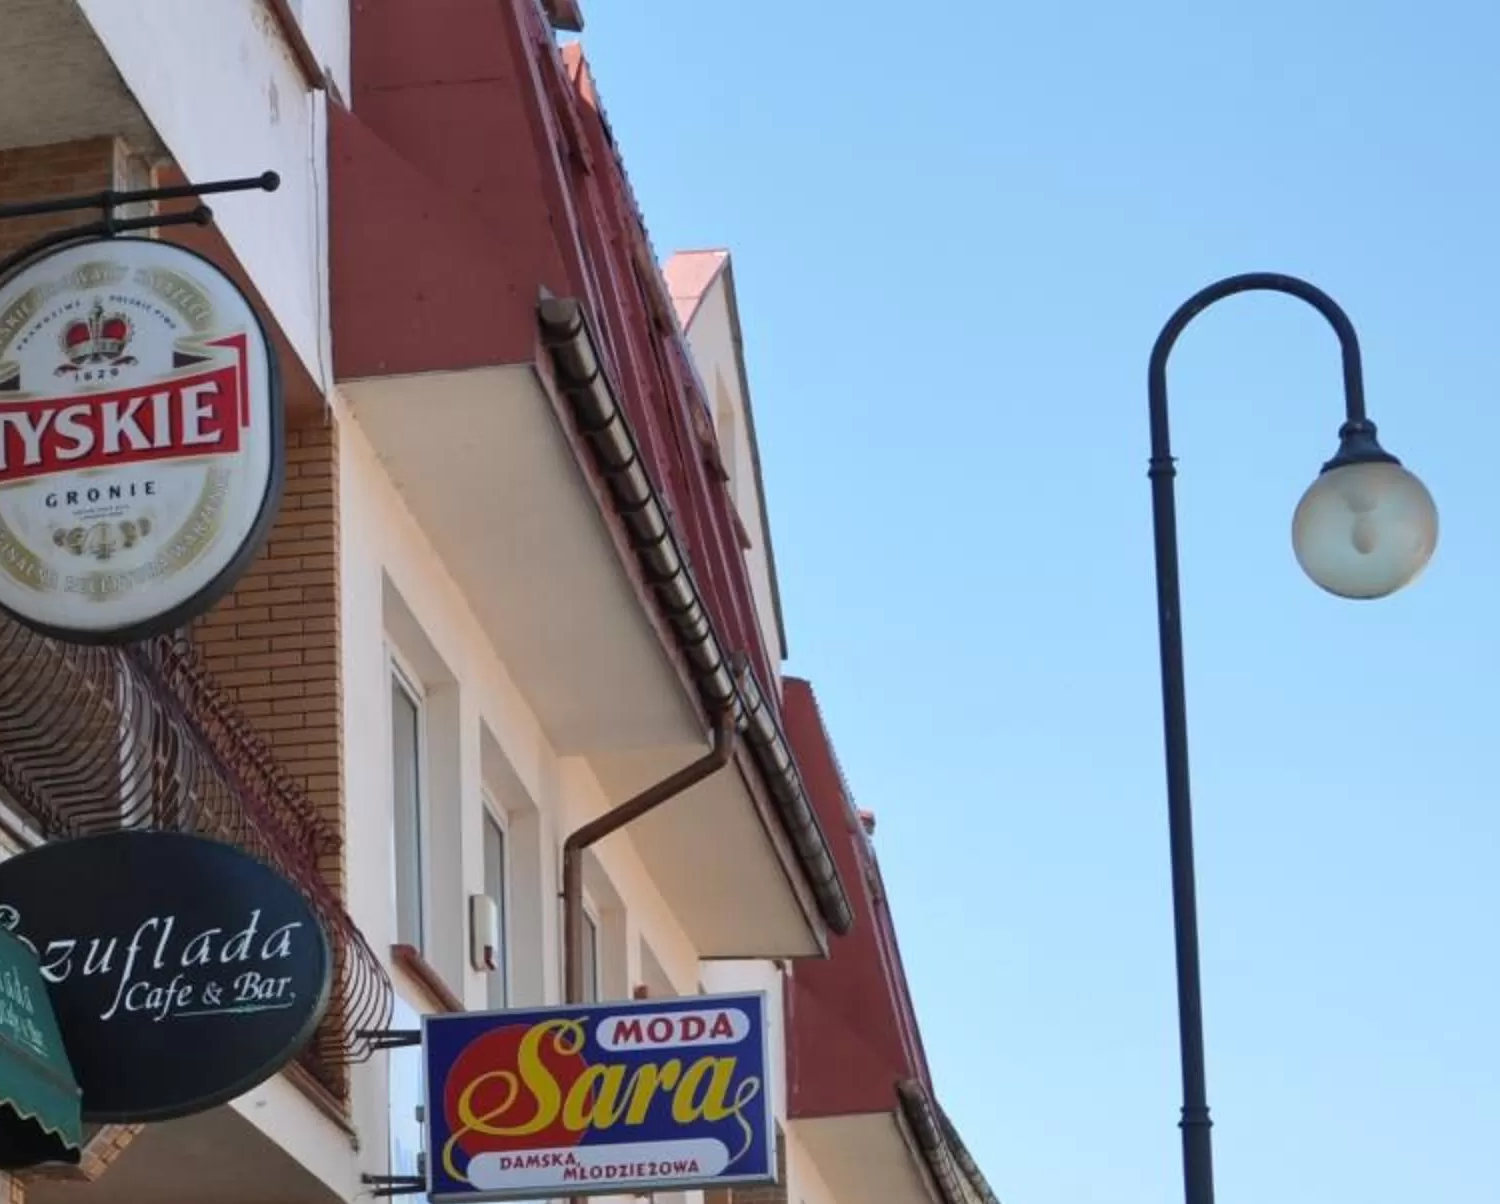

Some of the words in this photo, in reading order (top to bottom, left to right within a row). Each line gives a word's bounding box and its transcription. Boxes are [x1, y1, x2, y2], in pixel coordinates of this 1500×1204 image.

[45, 481, 157, 508] GRONIE
[124, 973, 193, 1022] Cafe
[202, 981, 223, 1005] &
[612, 1012, 734, 1045] MODA
[443, 1016, 760, 1181] Sara
